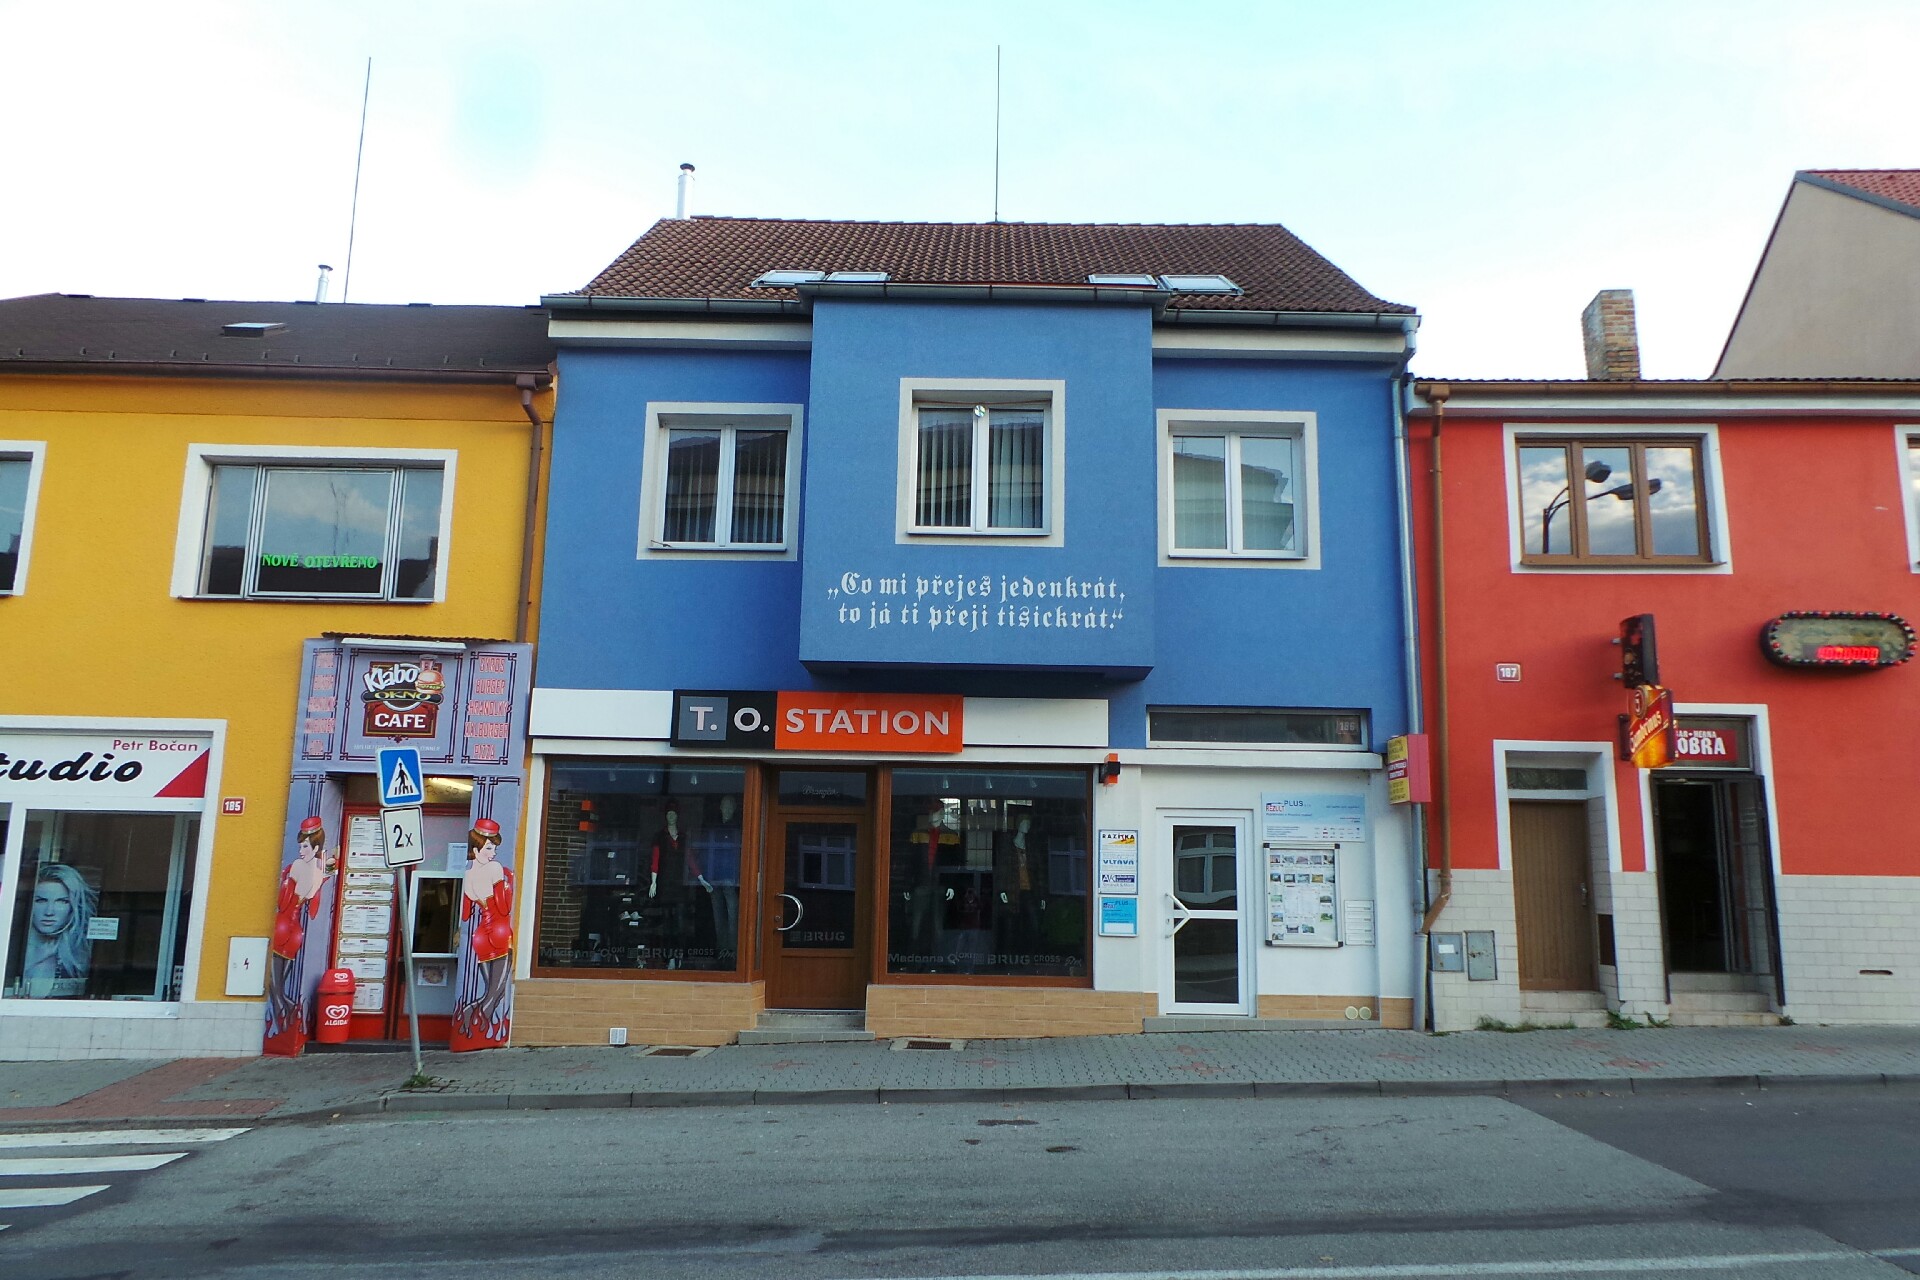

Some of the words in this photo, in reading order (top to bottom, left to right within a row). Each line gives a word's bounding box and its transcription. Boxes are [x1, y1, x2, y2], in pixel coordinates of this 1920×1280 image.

[304, 553, 378, 569] OTEVŘENO
[879, 572, 908, 595] mi
[916, 574, 991, 602] přeješ
[1000, 574, 1126, 604] jedenkrát,
[838, 602, 861, 624] to
[868, 601, 891, 630] já
[900, 602, 919, 625] ti
[928, 604, 988, 633] přeji
[363, 663, 418, 692] Klábo
[1500, 667, 1517, 677] 187
[374, 690, 431, 700] OKNO
[374, 713, 427, 728] CAFE
[689, 706, 718, 731] T.
[733, 707, 770, 733] O.
[786, 708, 949, 735] STATION
[113, 740, 143, 750] Petr
[149, 740, 198, 752] Bočan
[1677, 737, 1726, 755] OBRA
[0, 752, 143, 782] tudio
[224, 801, 242, 811] 185
[803, 931, 846, 942] BRUG
[687, 948, 714, 956] CROSS
[987, 953, 1031, 965] BRUG
[1033, 954, 1061, 963] CROSS
